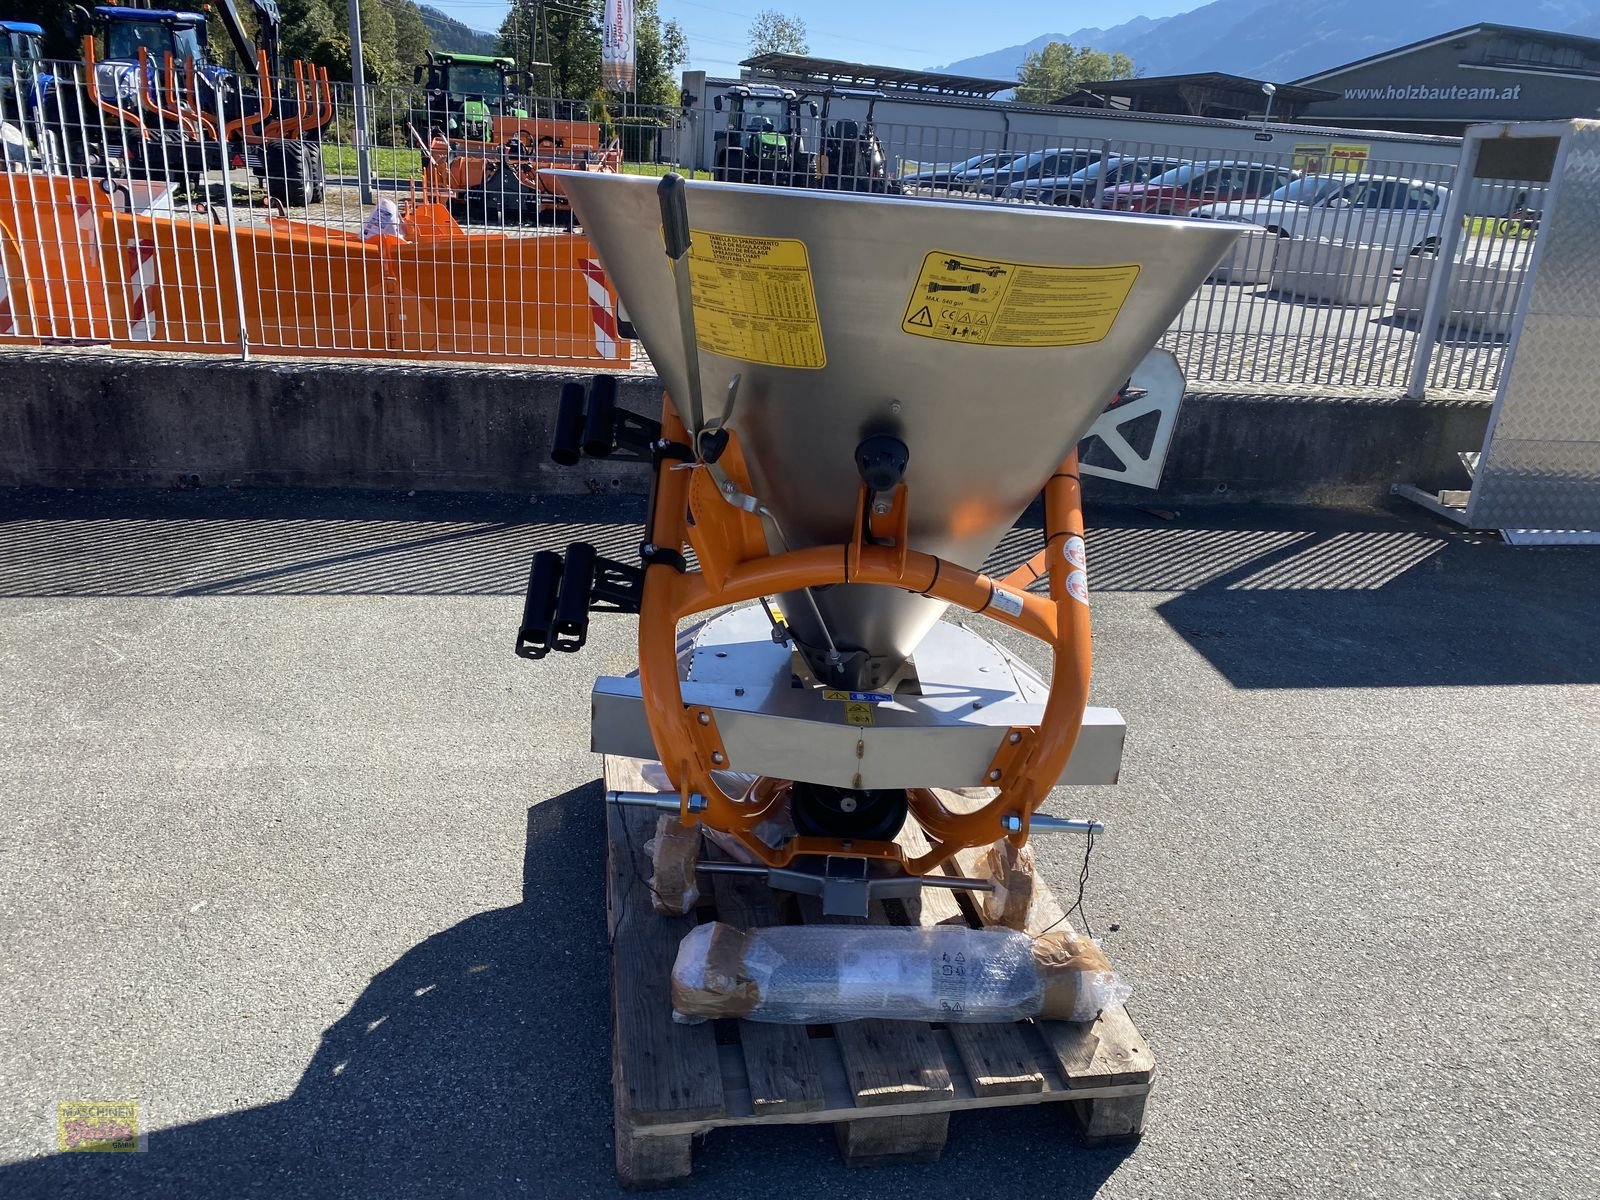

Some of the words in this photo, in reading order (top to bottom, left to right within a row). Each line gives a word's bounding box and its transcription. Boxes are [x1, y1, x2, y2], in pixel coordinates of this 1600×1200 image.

[1344, 84, 1521, 100] www.holzbauteam.at
[739, 238, 780, 246] SPANDIMENTO
[713, 249, 742, 257] SPREADING
